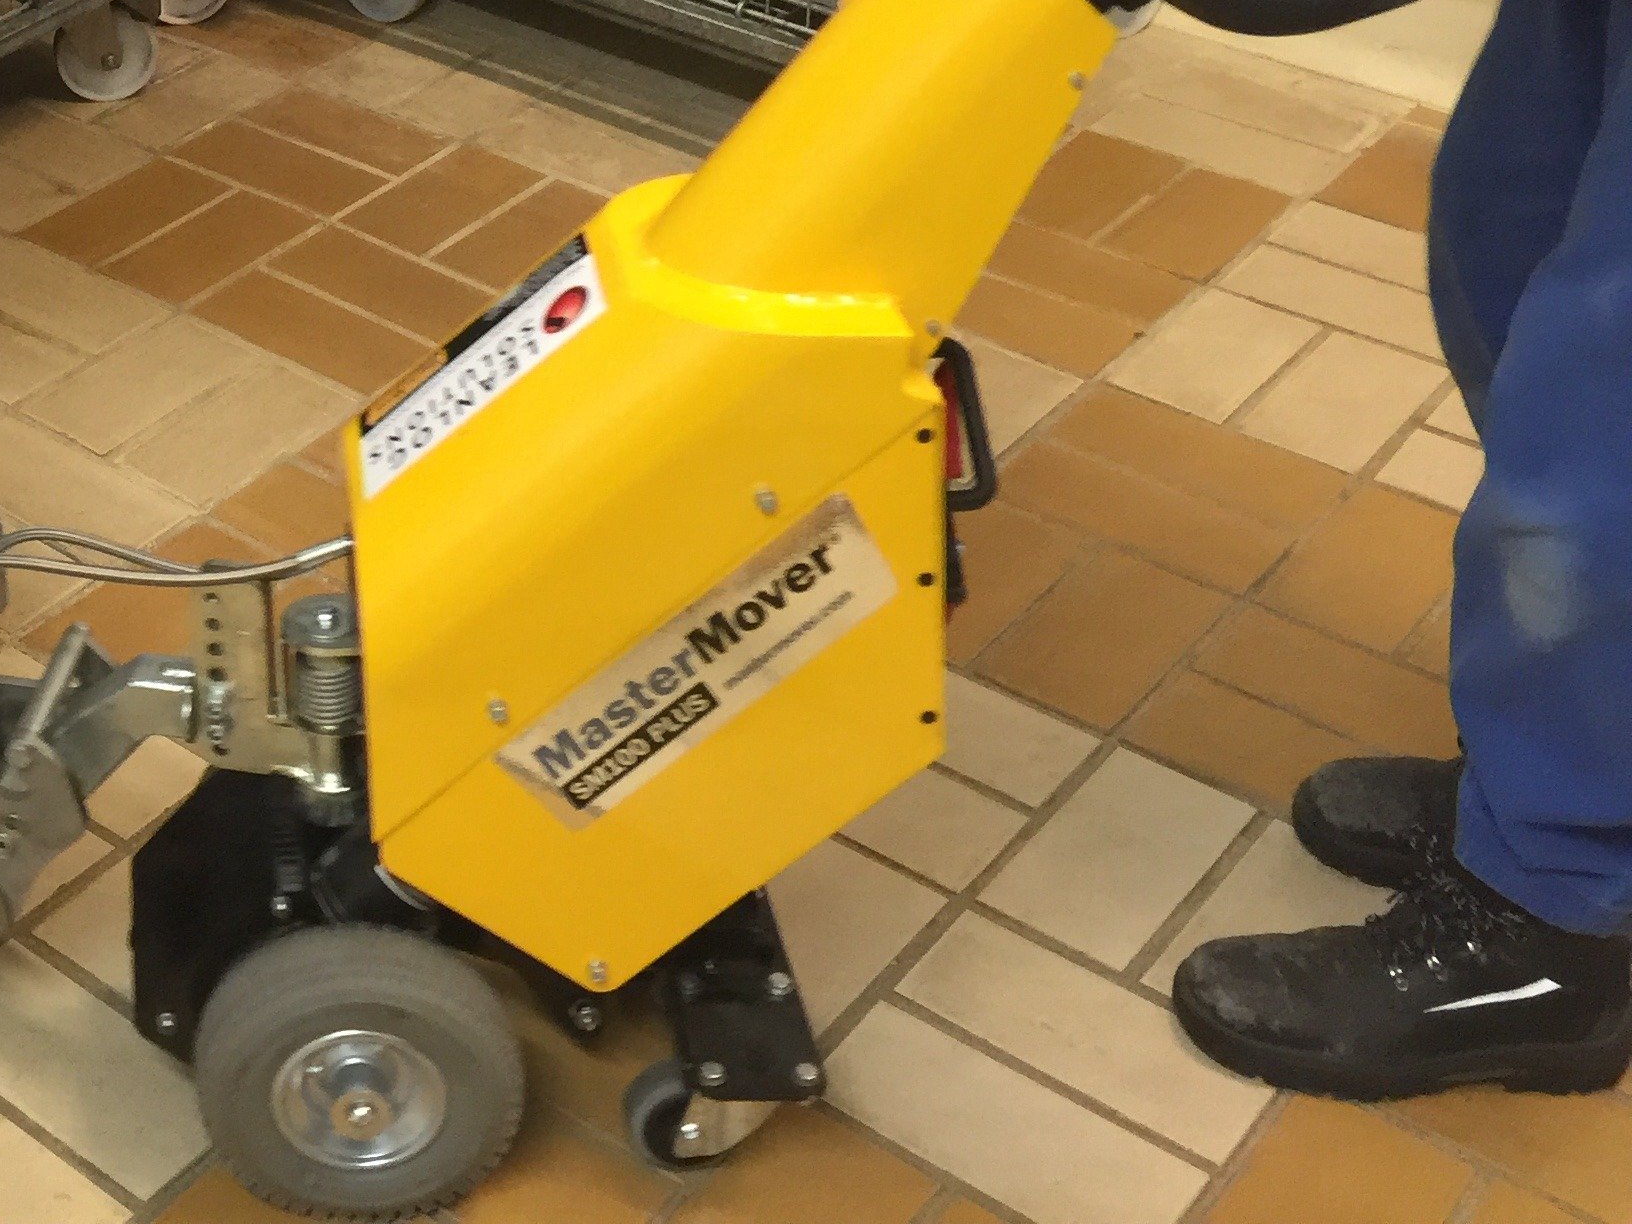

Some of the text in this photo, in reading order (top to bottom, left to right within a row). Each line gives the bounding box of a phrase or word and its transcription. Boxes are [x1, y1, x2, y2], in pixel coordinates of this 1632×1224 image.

[368, 319, 535, 465] SOLUTIONS
[531, 541, 834, 780] MasterMover
[646, 692, 712, 745] PLUS
